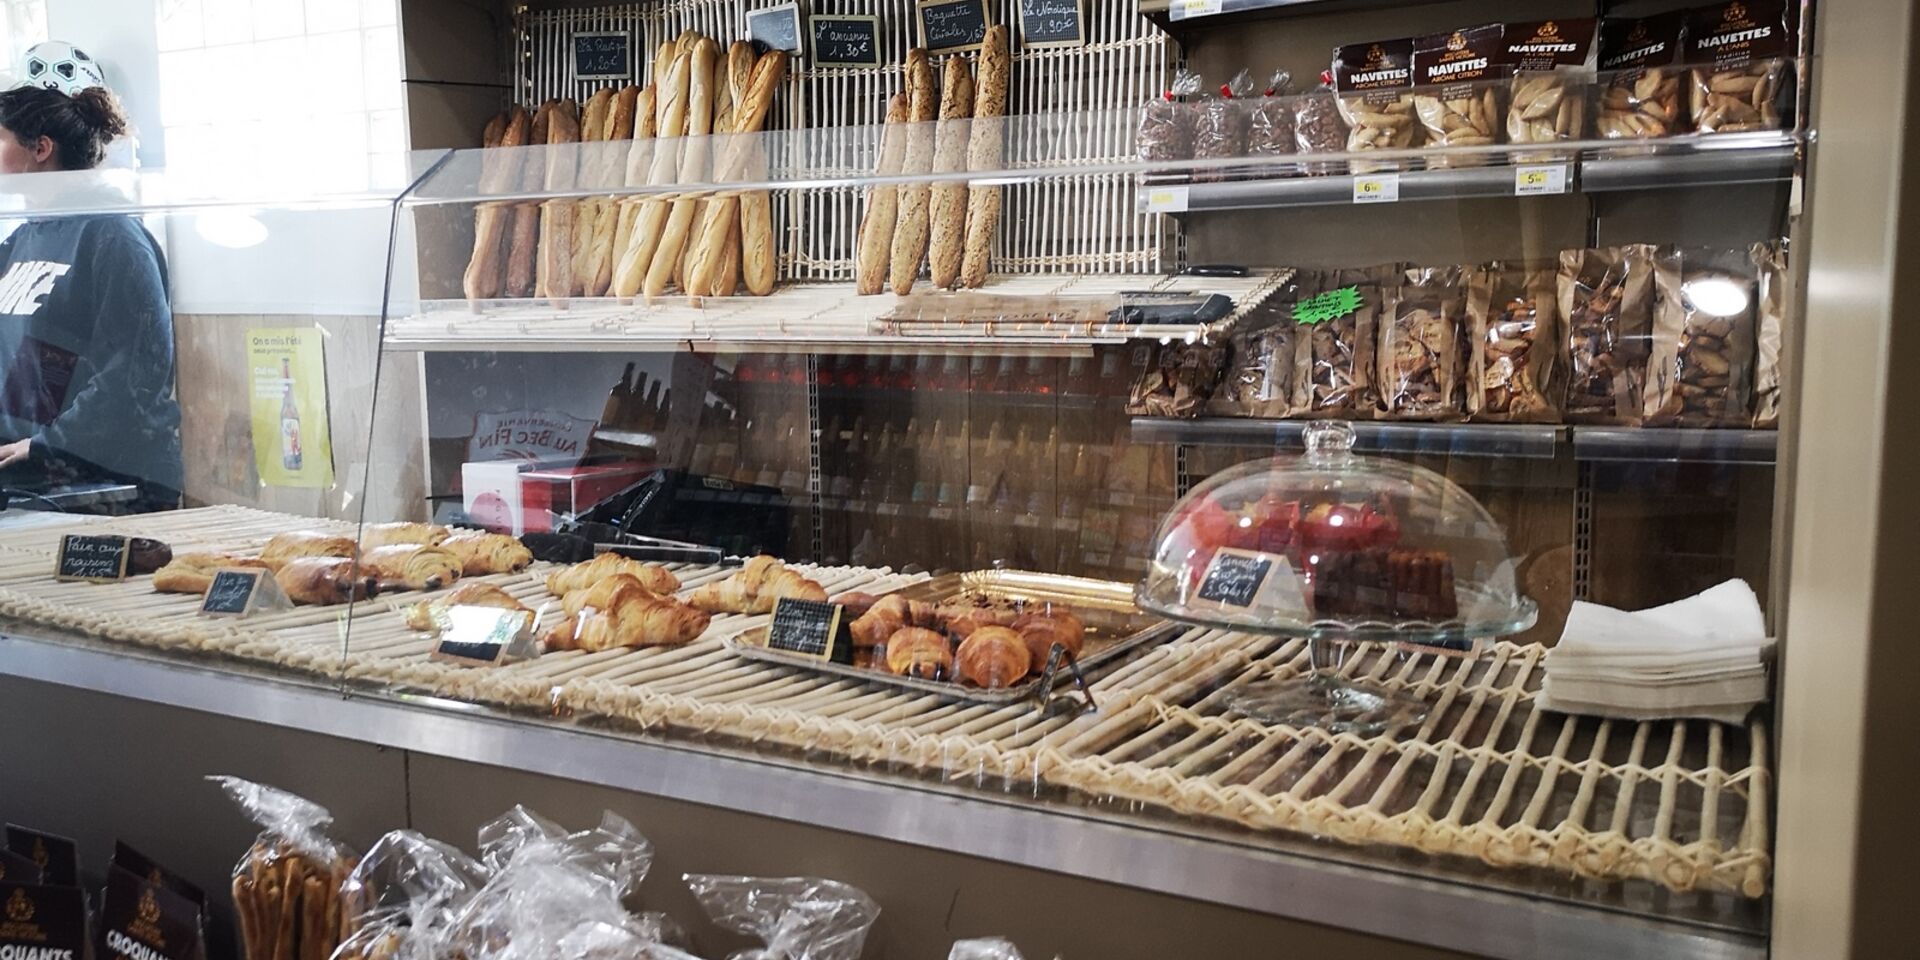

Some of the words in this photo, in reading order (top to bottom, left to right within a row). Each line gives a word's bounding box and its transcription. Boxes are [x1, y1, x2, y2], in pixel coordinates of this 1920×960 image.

[925, 4, 971, 25] Baguette
[1697, 26, 1771, 48] NAVETTES
[1508, 43, 1576, 53] NAVETTES
[1603, 42, 1665, 68] NAVETTES
[1428, 57, 1487, 77] NAVETTES
[1457, 70, 1483, 79] CITRON
[1351, 68, 1408, 84] NAVETTES
[1380, 78, 1404, 86] CITRON
[67, 536, 94, 551] Pain
[0, 943, 73, 960] QUANTS
